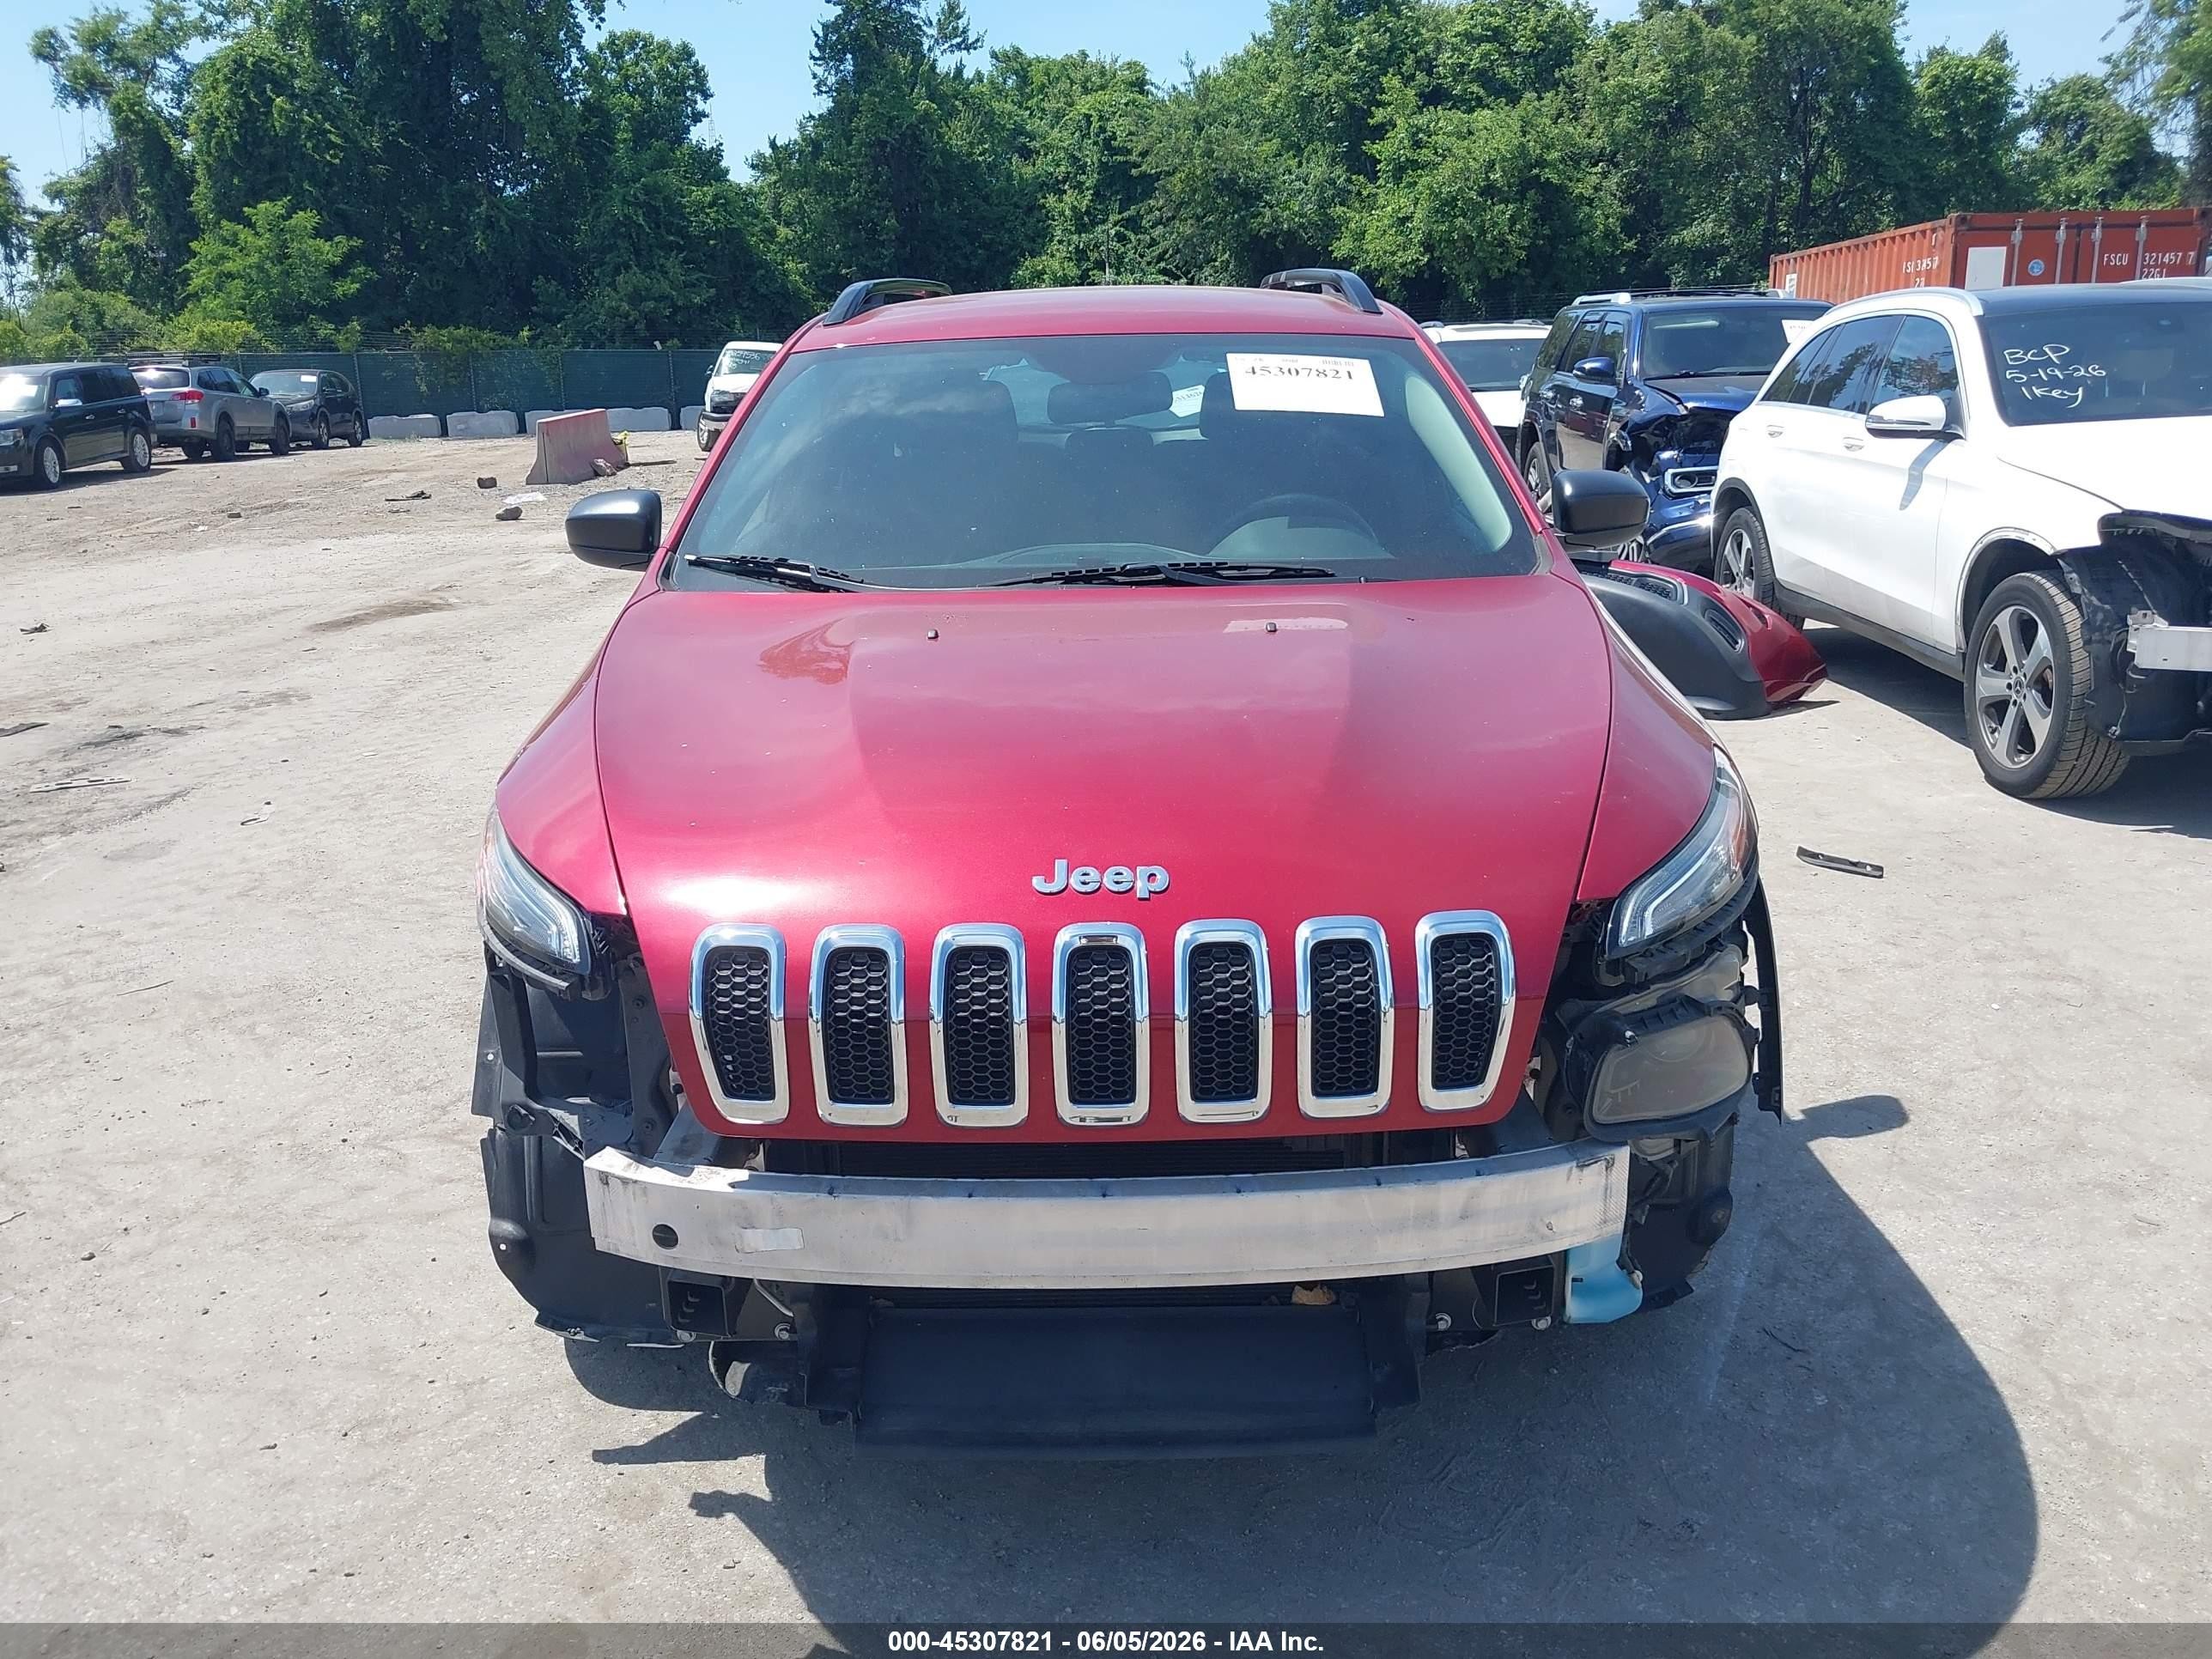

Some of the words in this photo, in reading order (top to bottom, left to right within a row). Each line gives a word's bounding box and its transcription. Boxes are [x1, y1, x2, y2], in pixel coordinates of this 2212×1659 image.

[2103, 253, 2129, 266] FSCU
[2142, 252, 2183, 265] 321457
[2003, 343, 2070, 365] BCP
[1244, 365, 1353, 380] 45307821
[2005, 364, 2106, 383] 5-19-26
[1031, 858, 1170, 901] Jeep
